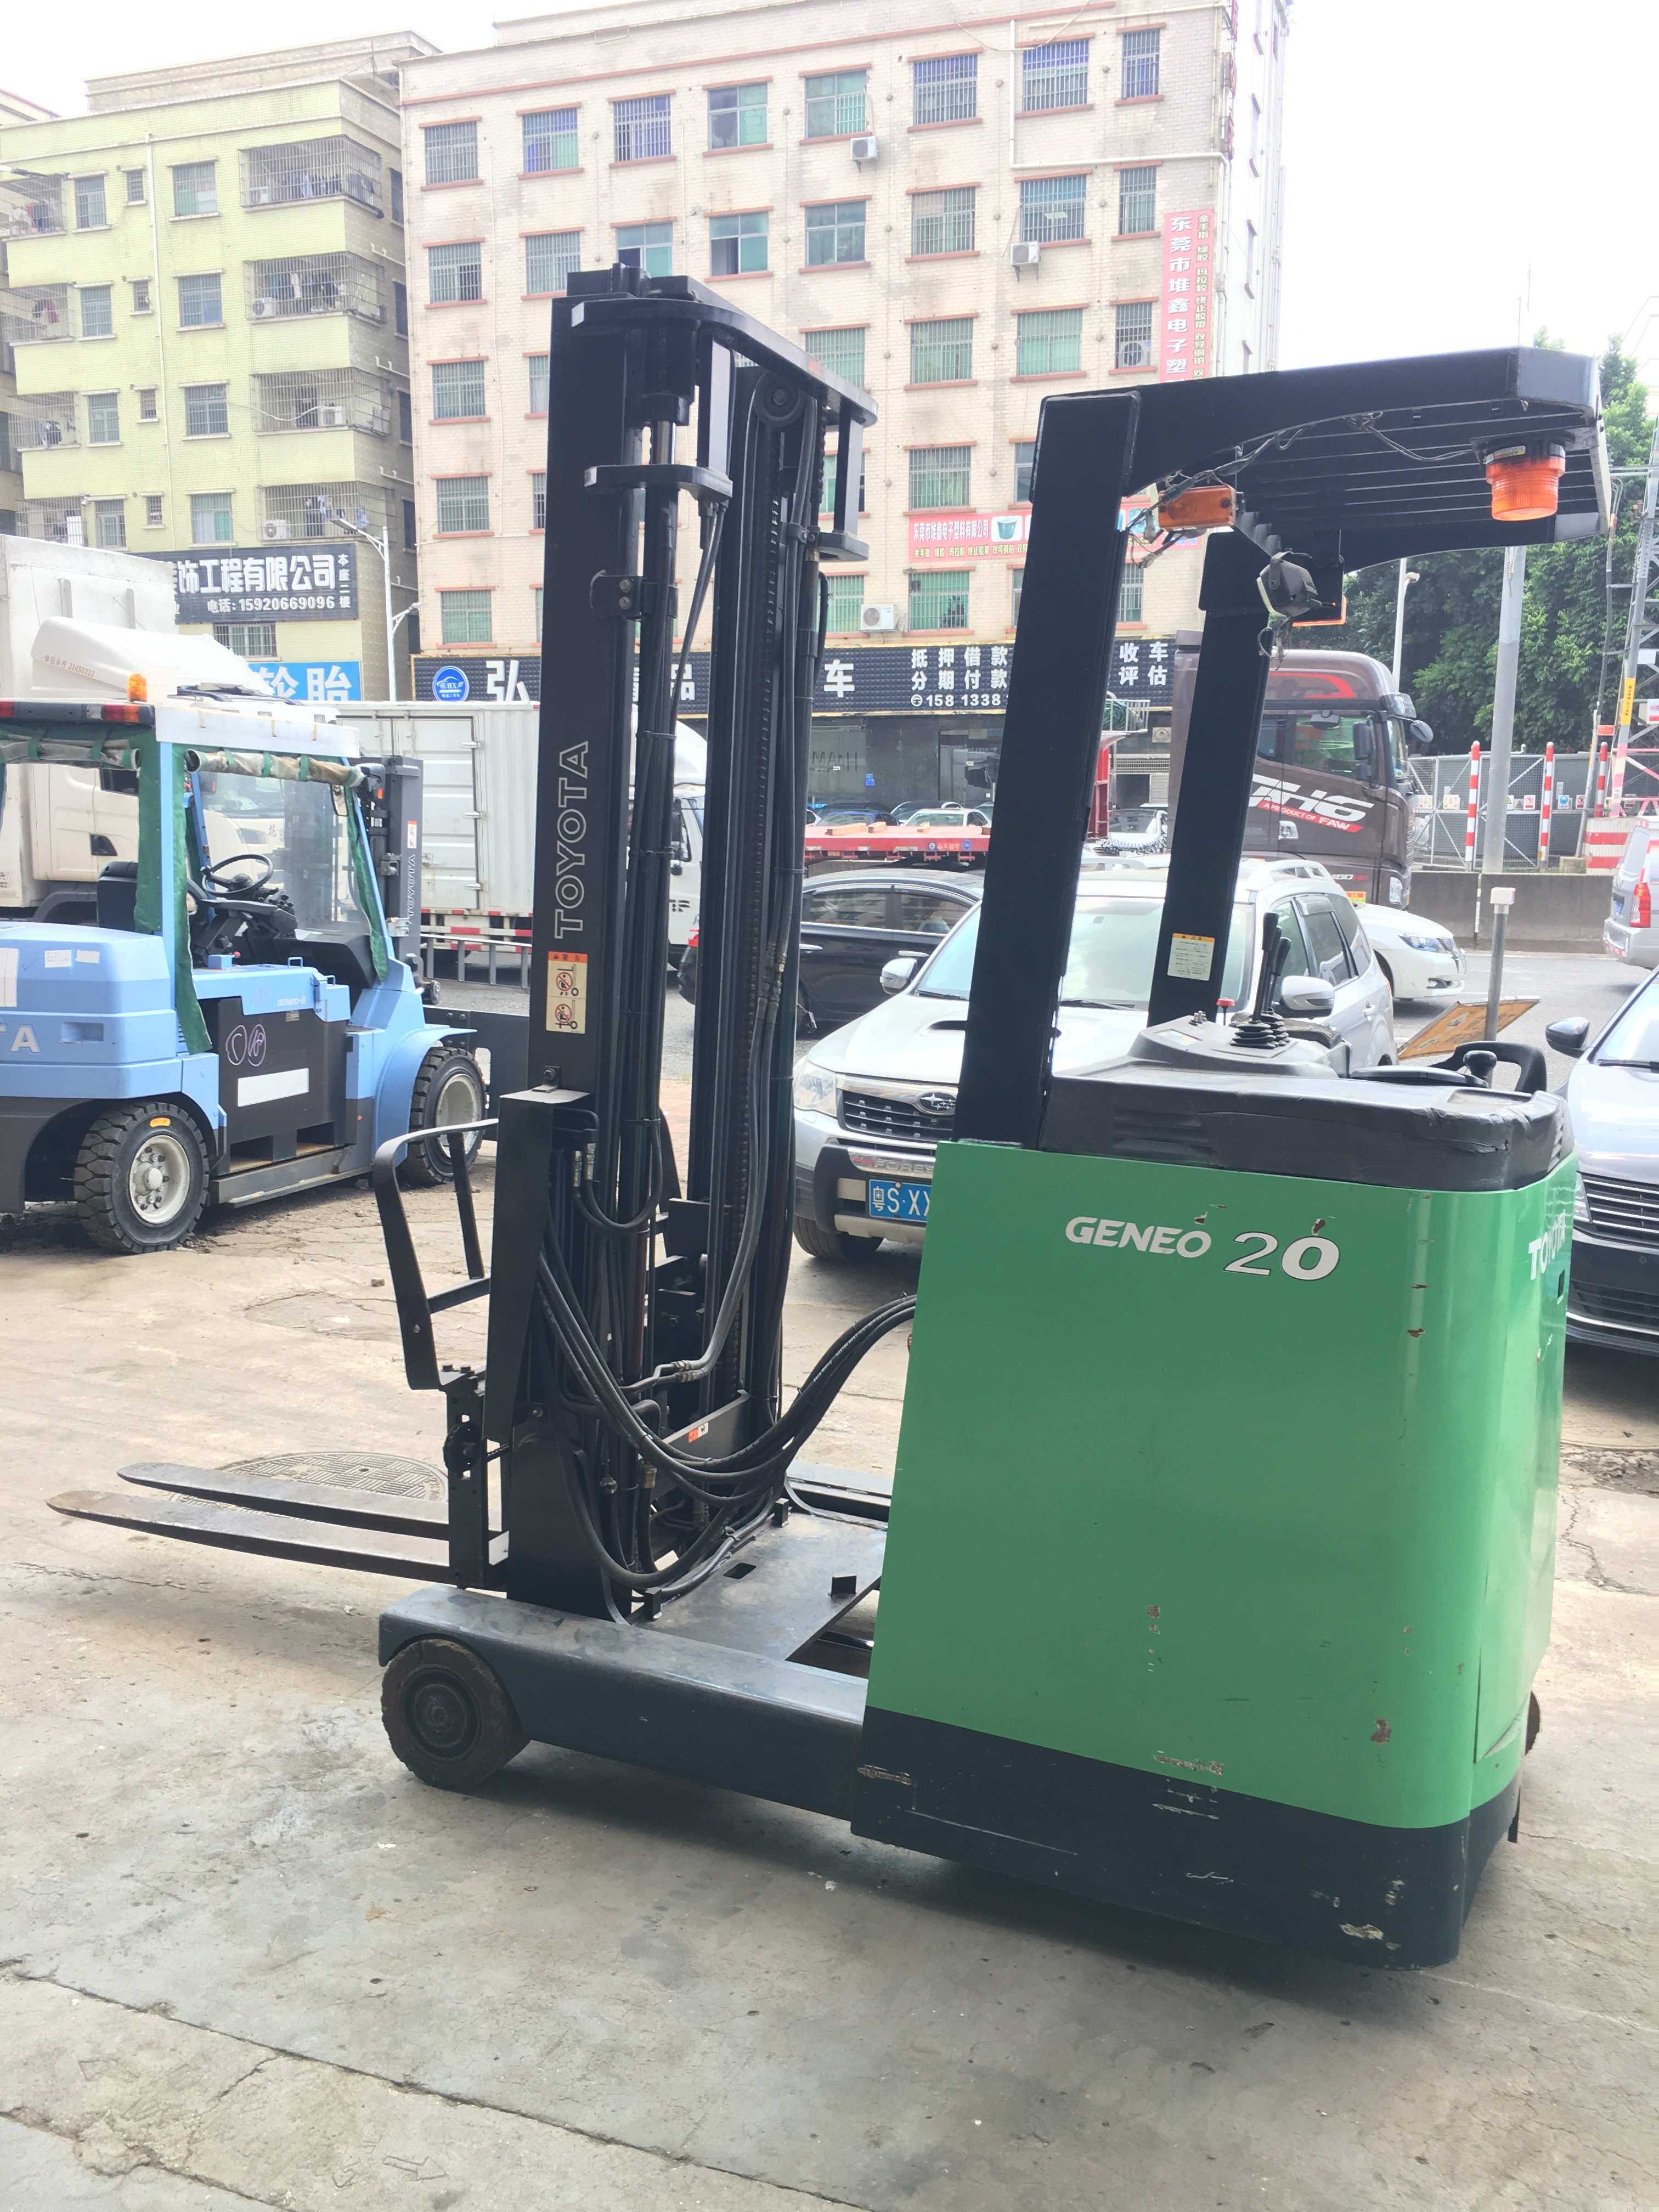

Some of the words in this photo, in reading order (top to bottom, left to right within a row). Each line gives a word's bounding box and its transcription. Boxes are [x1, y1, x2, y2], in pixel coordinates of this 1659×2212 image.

[1166, 217, 1192, 382] 东莞市堆鑫电子塑
[911, 646, 1008, 669] 抵押借款
[1119, 641, 1169, 663] 收车
[911, 669, 1008, 691] 分期付款
[1118, 665, 1168, 686] 评估
[926, 694, 955, 707] 158
[1271, 804, 1306, 818] PRODUCT
[1319, 817, 1351, 831] FAW
[554, 741, 589, 939] TOYOTA
[1065, 1216, 1212, 1258] GENEO
[1223, 1231, 1340, 1281] 20
